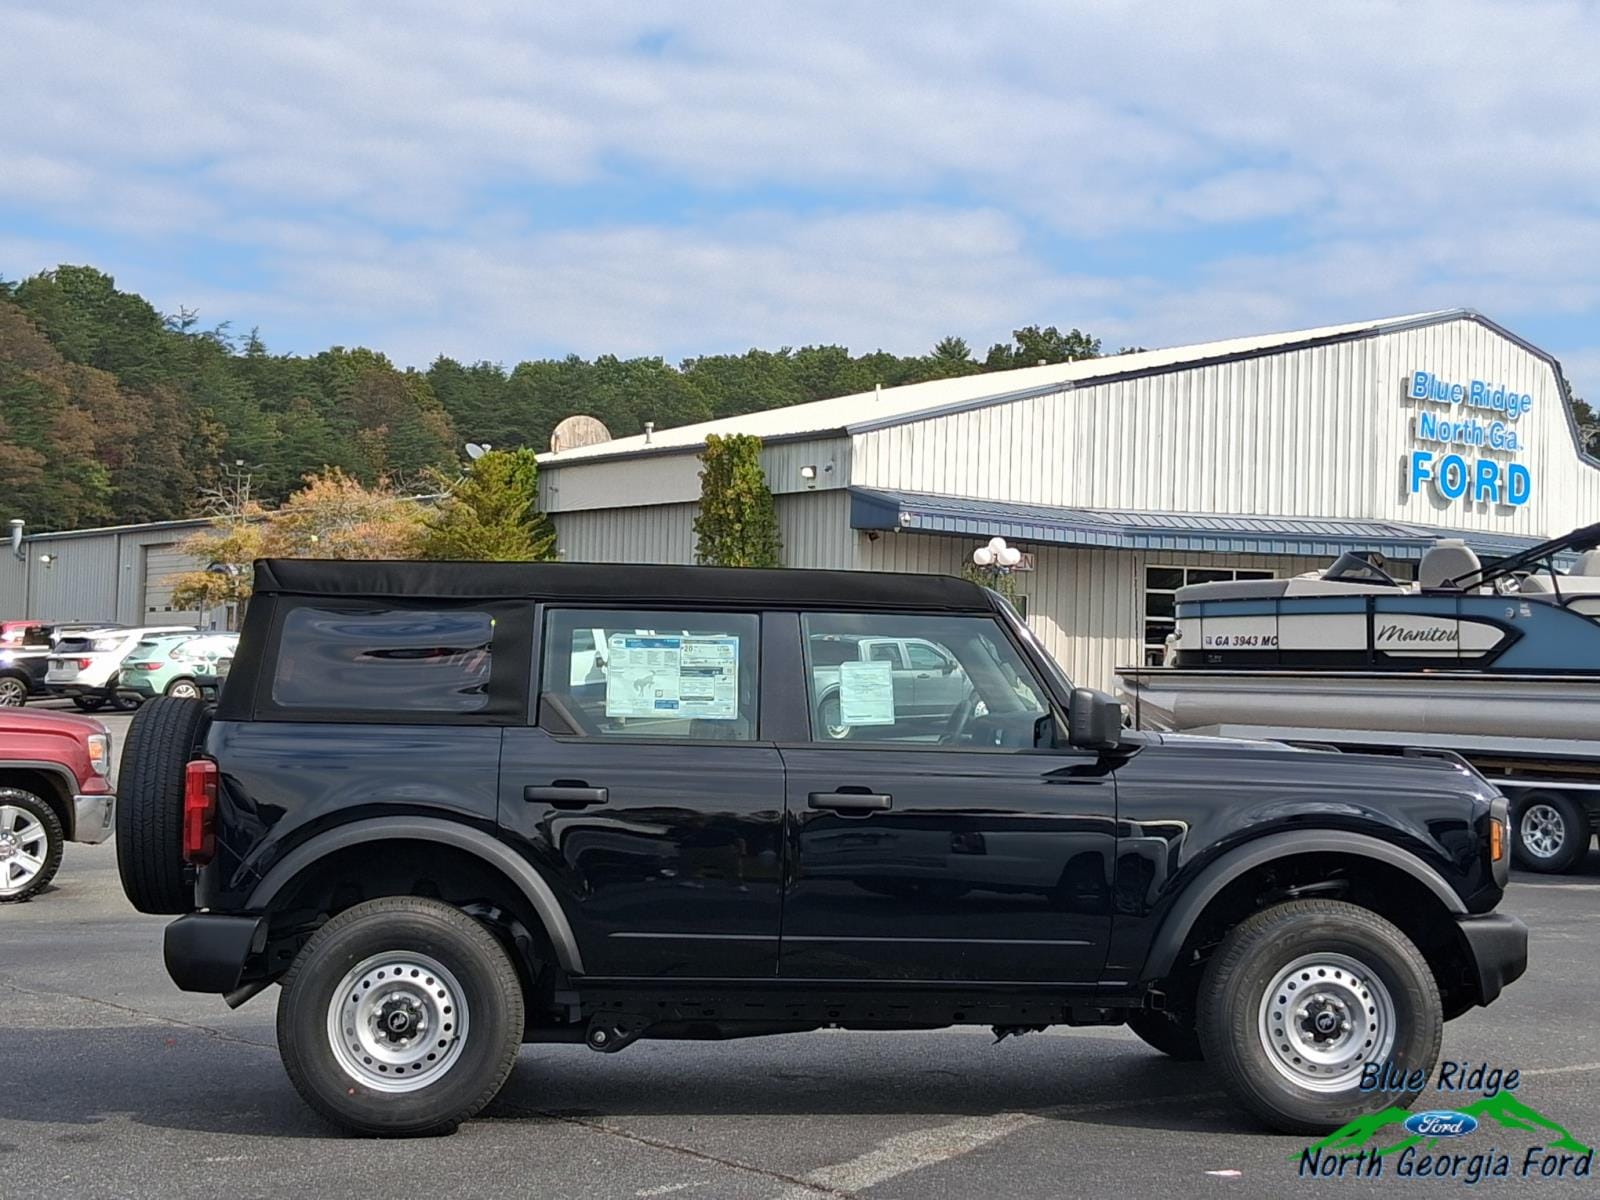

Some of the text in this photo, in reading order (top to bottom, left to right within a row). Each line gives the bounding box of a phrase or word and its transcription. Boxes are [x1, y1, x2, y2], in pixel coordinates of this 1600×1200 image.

[1412, 371, 1532, 418] Blue Ridge
[1420, 412, 1484, 445] North
[1411, 451, 1531, 506] FORD
[1215, 635, 1229, 646] GA
[1232, 635, 1258, 646] 3943
[1376, 625, 1459, 642] Manitou
